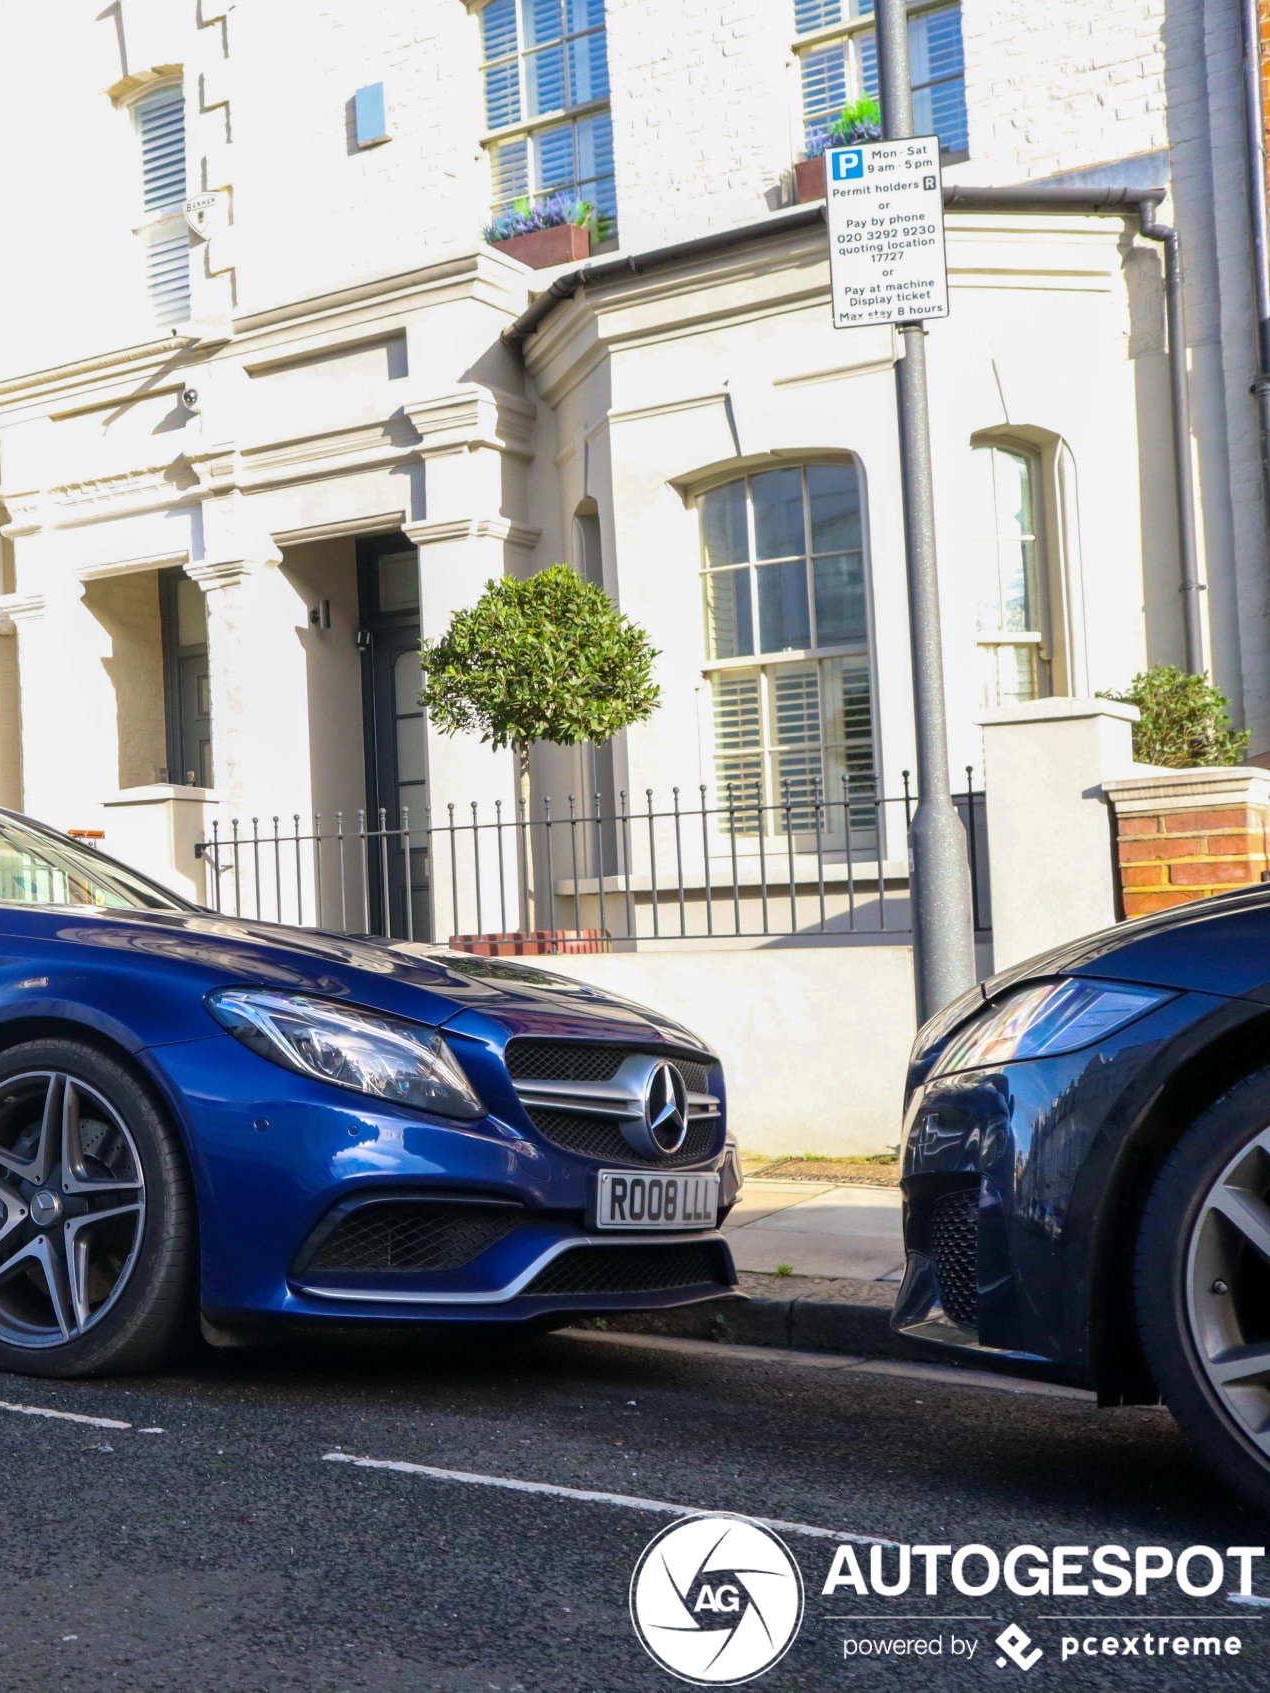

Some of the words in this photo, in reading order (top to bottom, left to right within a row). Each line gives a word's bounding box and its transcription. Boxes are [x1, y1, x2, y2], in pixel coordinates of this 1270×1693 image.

[872, 150, 897, 160] Mon
[907, 146, 927, 156] Sat
[839, 153, 859, 178] P
[868, 164, 874, 173] 9
[878, 164, 894, 172] am
[905, 159, 912, 169] 5
[915, 160, 932, 170] pm
[833, 186, 871, 198] Permit
[876, 182, 919, 193] holders
[925, 178, 934, 189] R
[186, 197, 216, 212] BANHAM
[878, 201, 890, 210] or
[847, 218, 866, 228] Pay
[872, 216, 885, 226] by
[890, 213, 925, 224] phone
[838, 232, 862, 243] 020
[867, 229, 898, 240] 3292
[903, 225, 935, 236] 9230
[839, 242, 883, 256] quoting
[888, 237, 935, 250] location
[872, 252, 904, 263] 17727
[882, 268, 894, 277] or
[845, 286, 865, 296] Pay
[870, 284, 881, 293] at
[886, 280, 934, 292] machine
[850, 295, 892, 307] Display
[897, 290, 931, 302] ticket
[840, 312, 862, 322] Max
[898, 307, 904, 316] 8
[910, 304, 943, 314] hours
[610, 1178, 678, 1221] RO08
[682, 1180, 711, 1220] LLL
